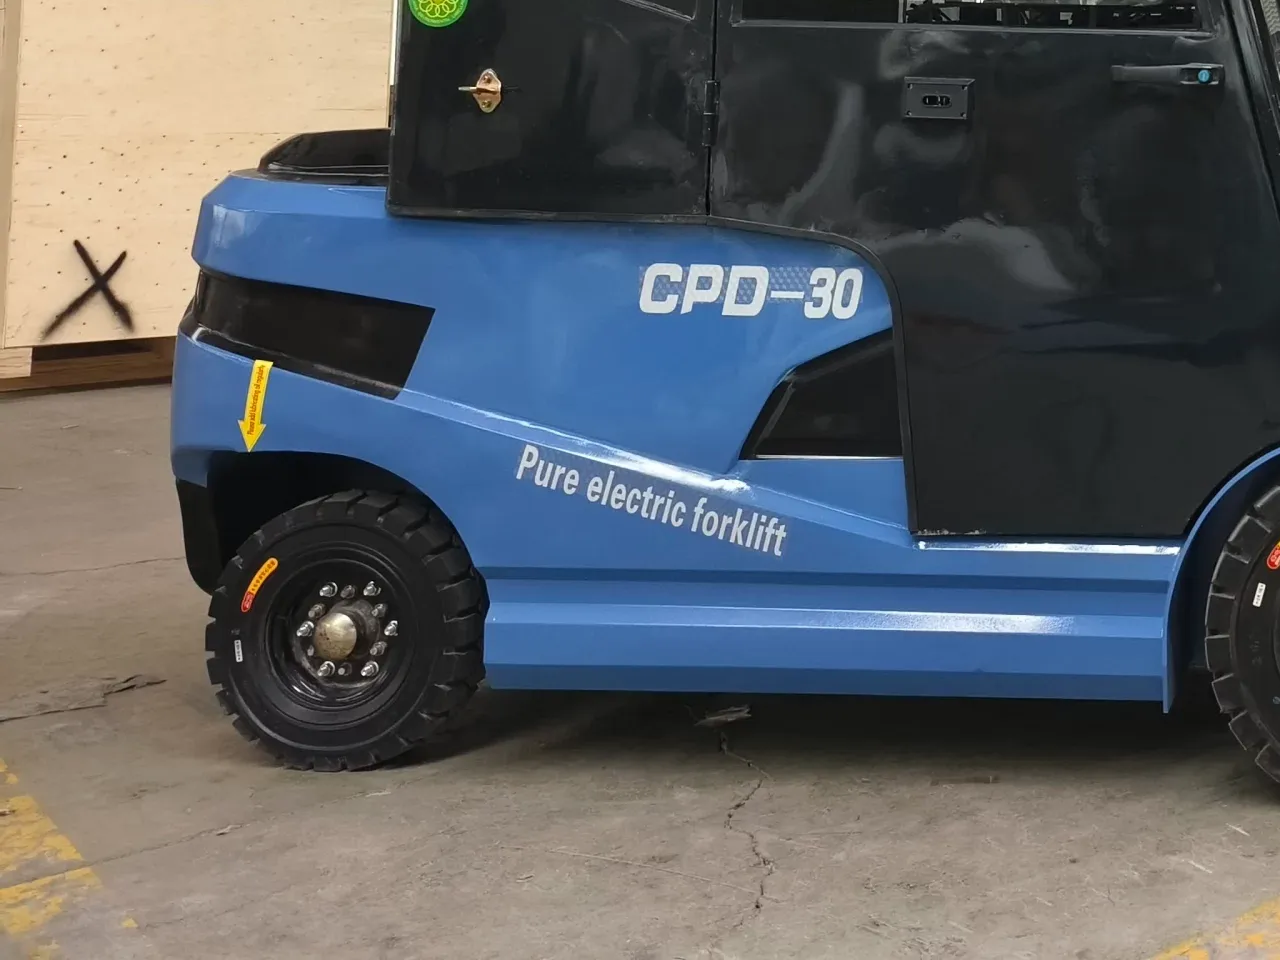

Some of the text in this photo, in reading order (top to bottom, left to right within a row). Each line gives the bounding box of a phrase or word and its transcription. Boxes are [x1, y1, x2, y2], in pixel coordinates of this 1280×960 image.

[639, 263, 863, 319] CPD-30
[515, 444, 787, 557] Pure electric forklift
